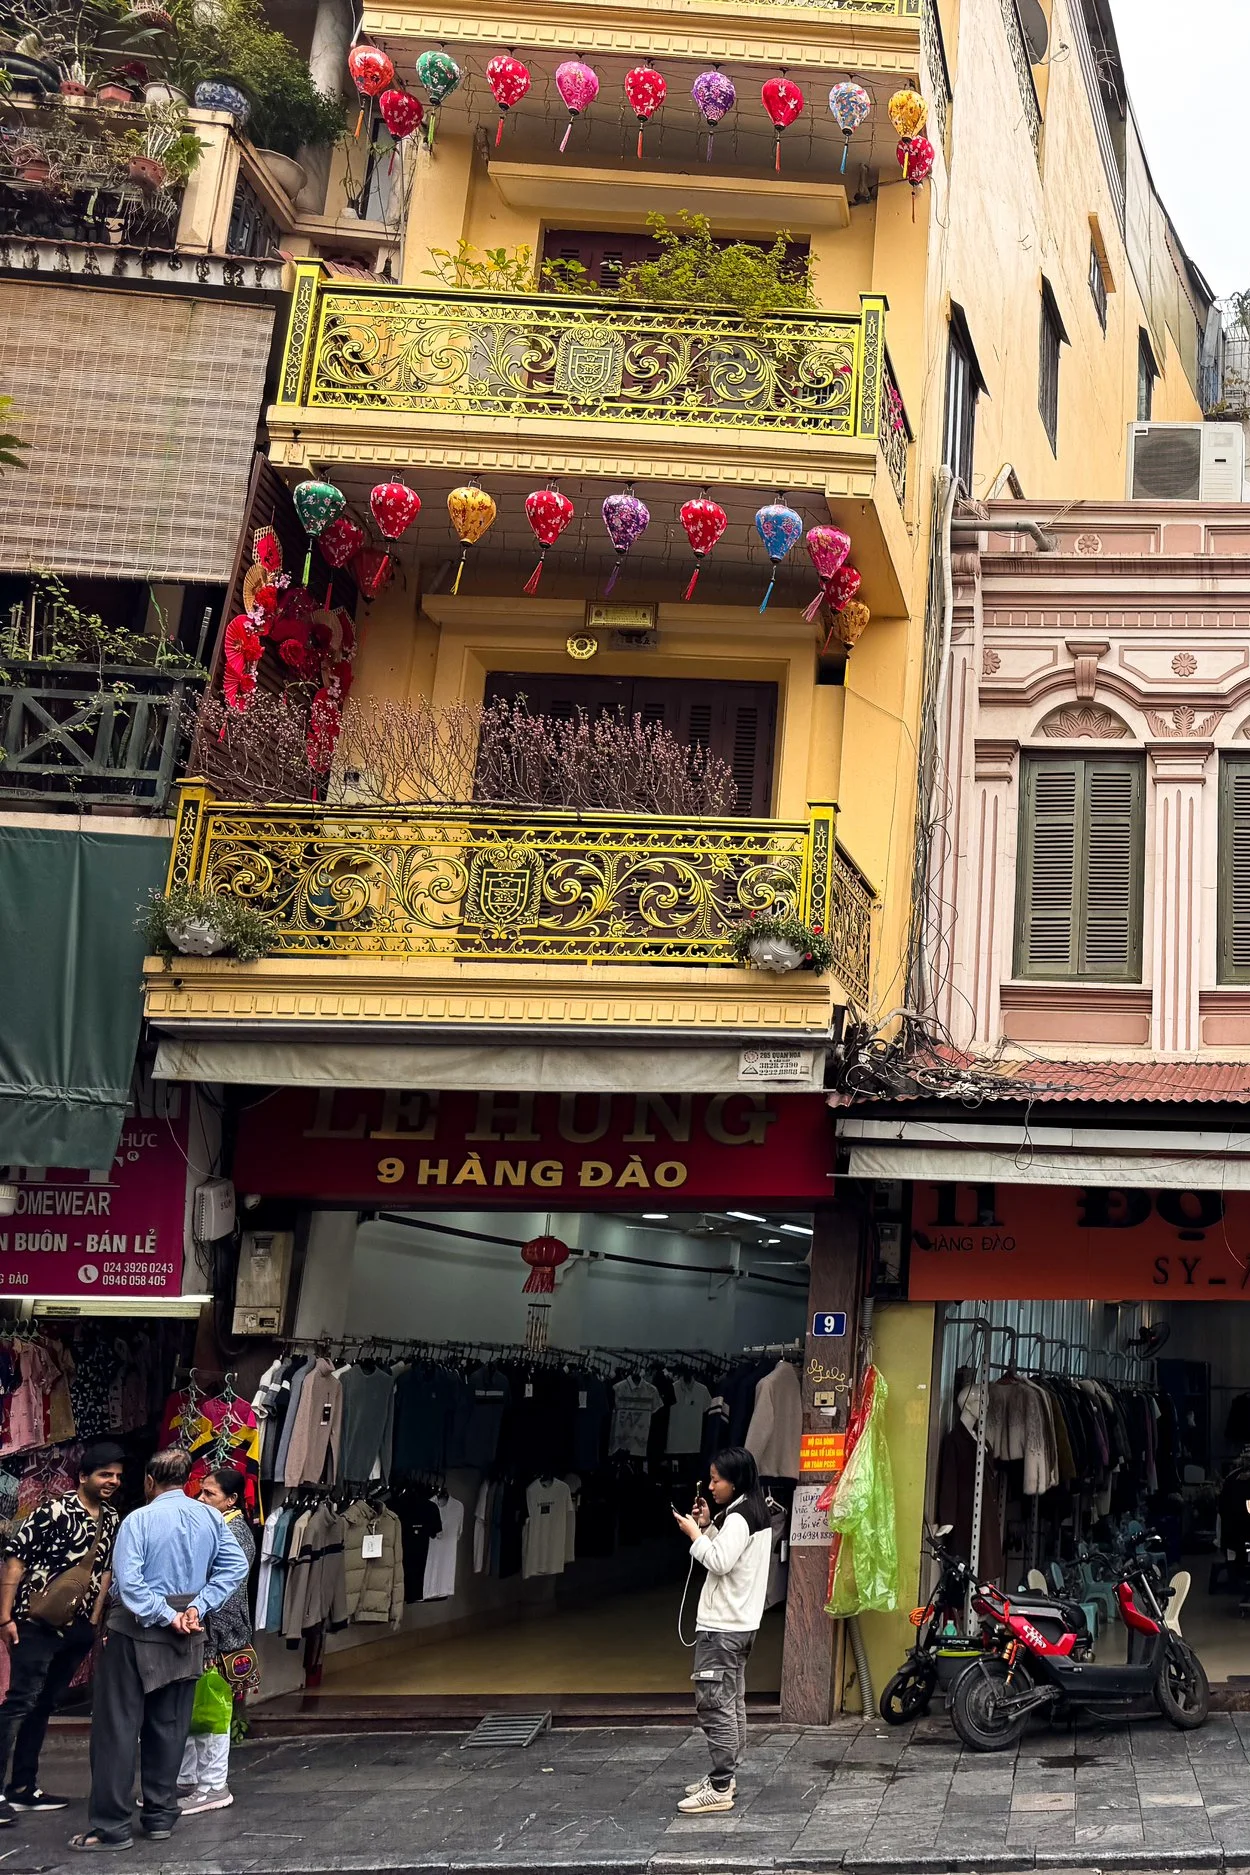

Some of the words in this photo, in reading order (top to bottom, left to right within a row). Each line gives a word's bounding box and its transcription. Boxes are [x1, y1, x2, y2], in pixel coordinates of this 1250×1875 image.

[376, 1157, 406, 1184] 9
[416, 1151, 564, 1187] HÀNG
[577, 1155, 688, 1188] ĐÀO
[14, 1229, 68, 1252] BUÔN
[86, 1230, 126, 1253] BÁN
[134, 1228, 157, 1253] LẺ
[981, 1233, 1016, 1251] ĐÀO
[103, 1263, 121, 1273] 024
[124, 1263, 148, 1273] 3926
[149, 1263, 174, 1274] 0243
[8, 1271, 28, 1285] ĐÀO
[102, 1275, 127, 1285] 0946
[129, 1275, 146, 1285] 058
[148, 1275, 166, 1286] 405
[824, 1316, 835, 1333] 9
